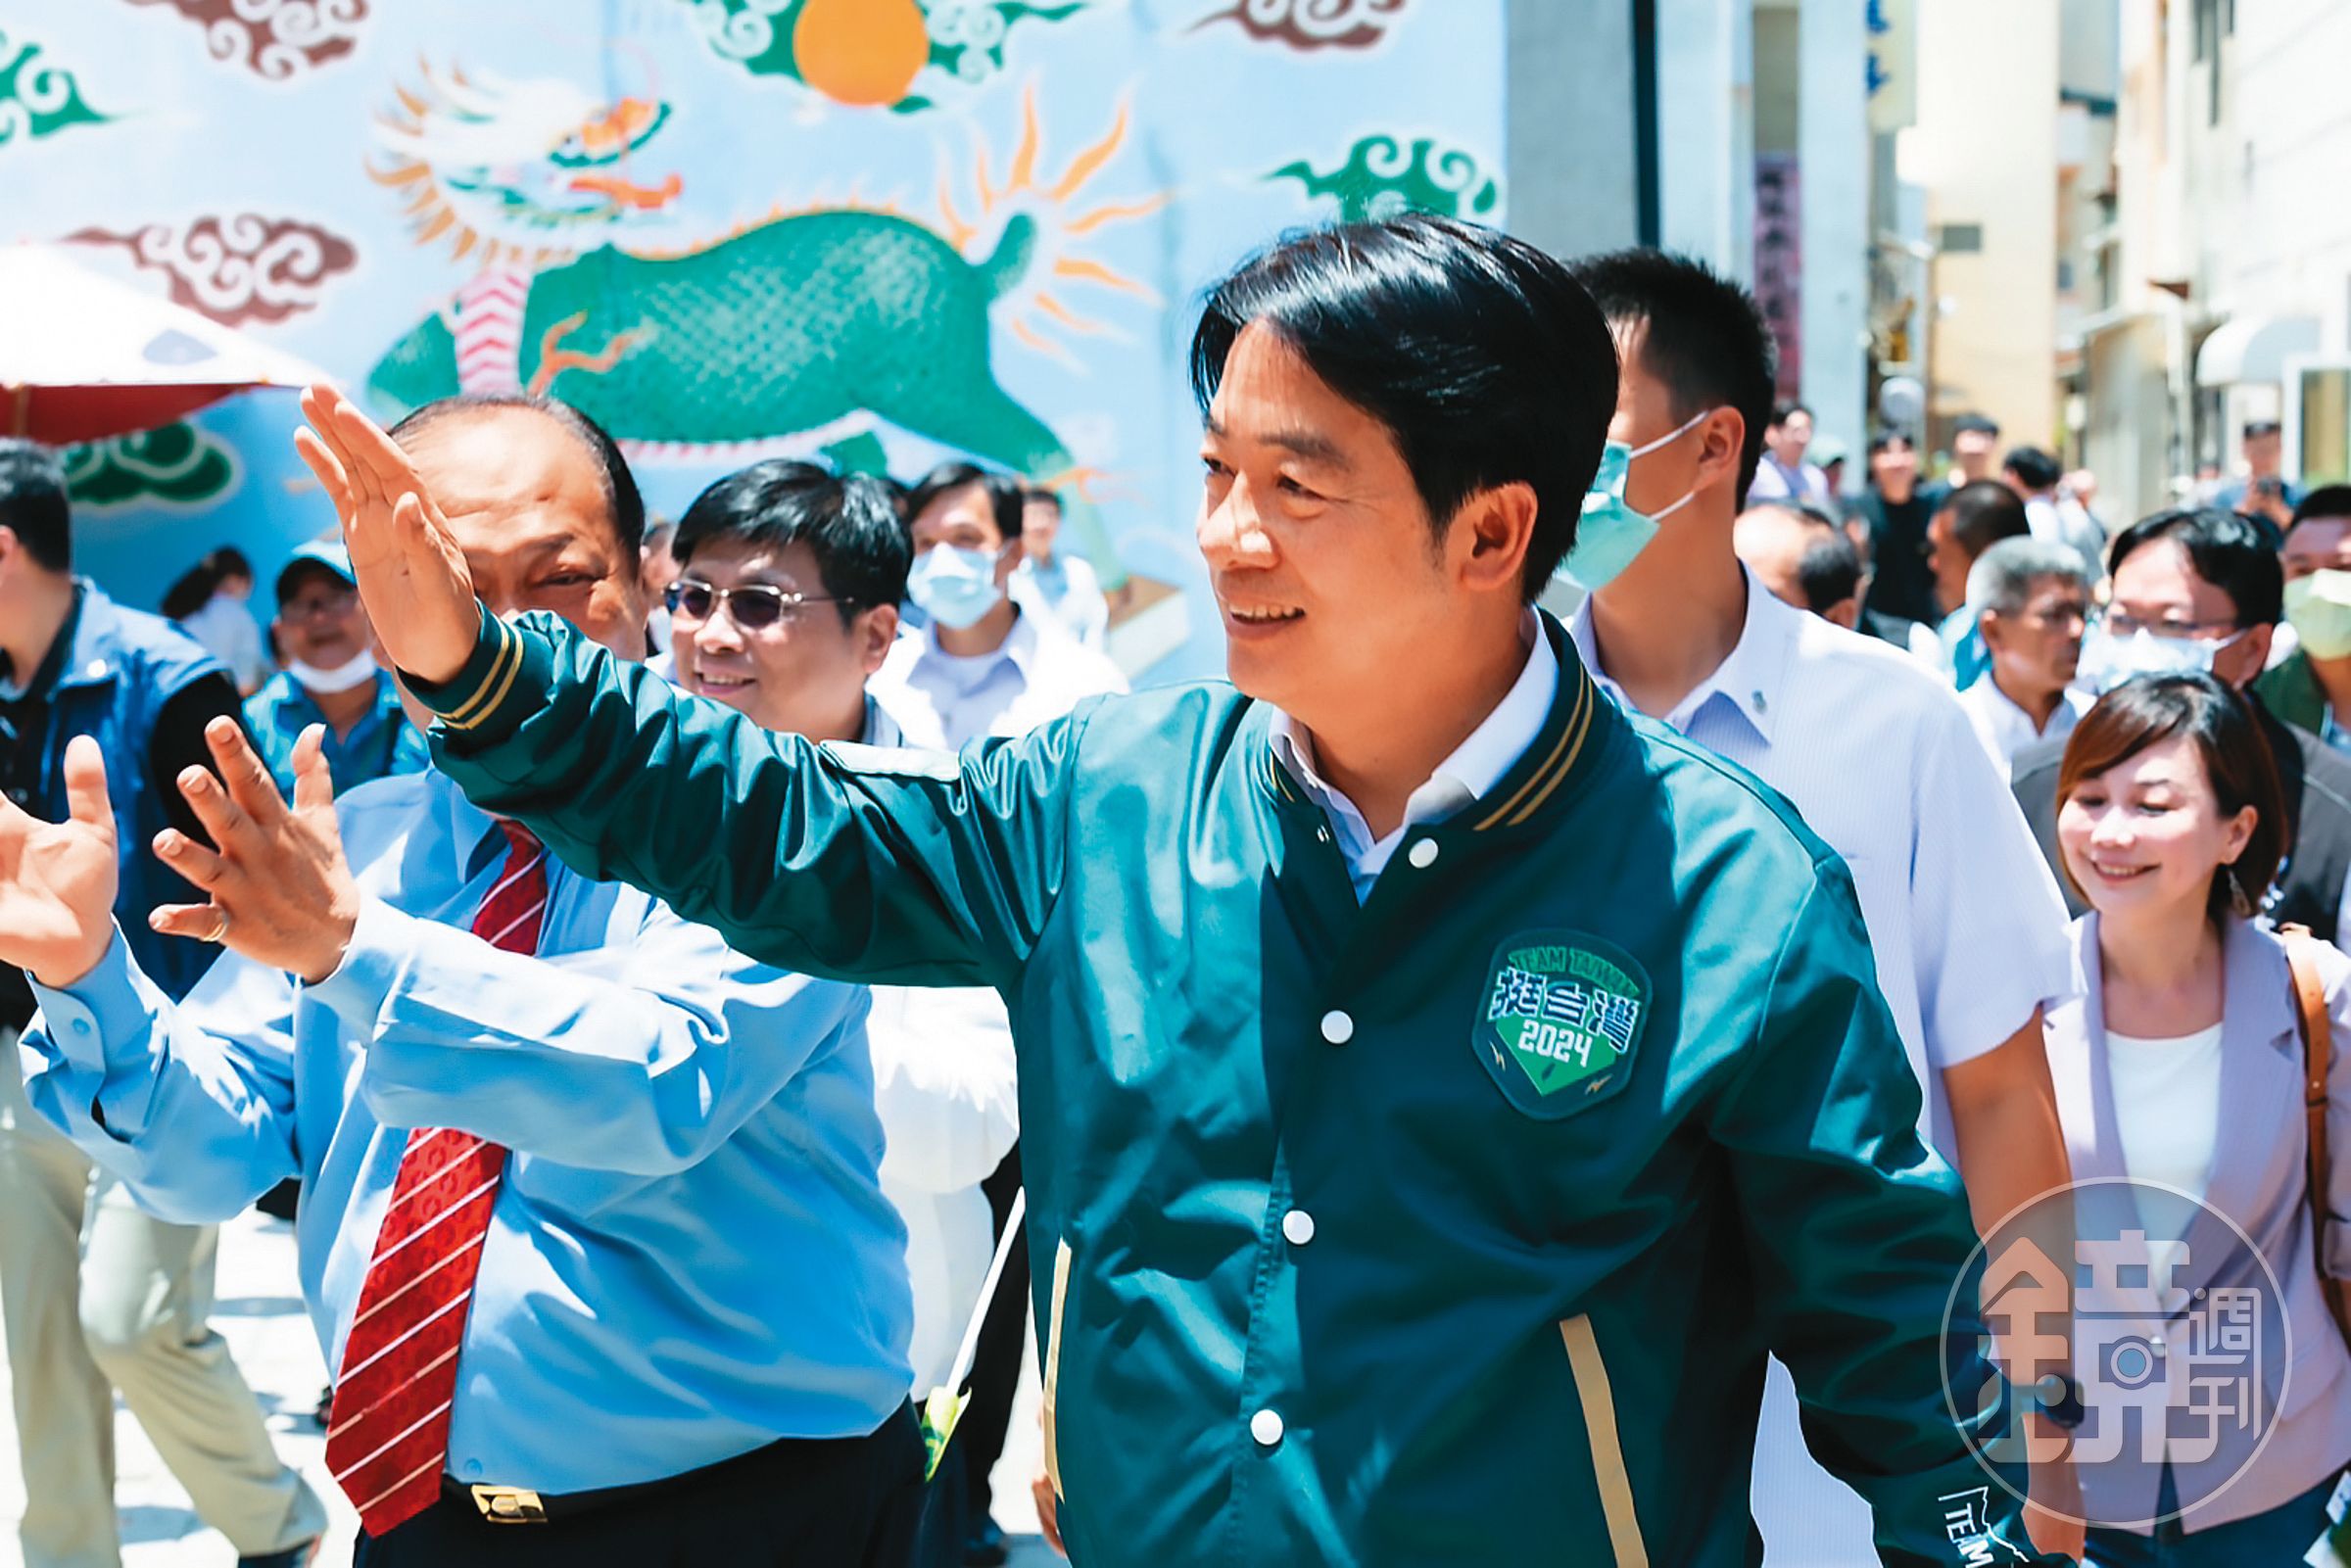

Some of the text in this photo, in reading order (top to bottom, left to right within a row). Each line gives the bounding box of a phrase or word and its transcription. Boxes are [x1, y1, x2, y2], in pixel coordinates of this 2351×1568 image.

[1509, 946, 1566, 973] TEAM
[1518, 1020, 1593, 1069] 2024
[1944, 1502, 1994, 1568] TEAM
